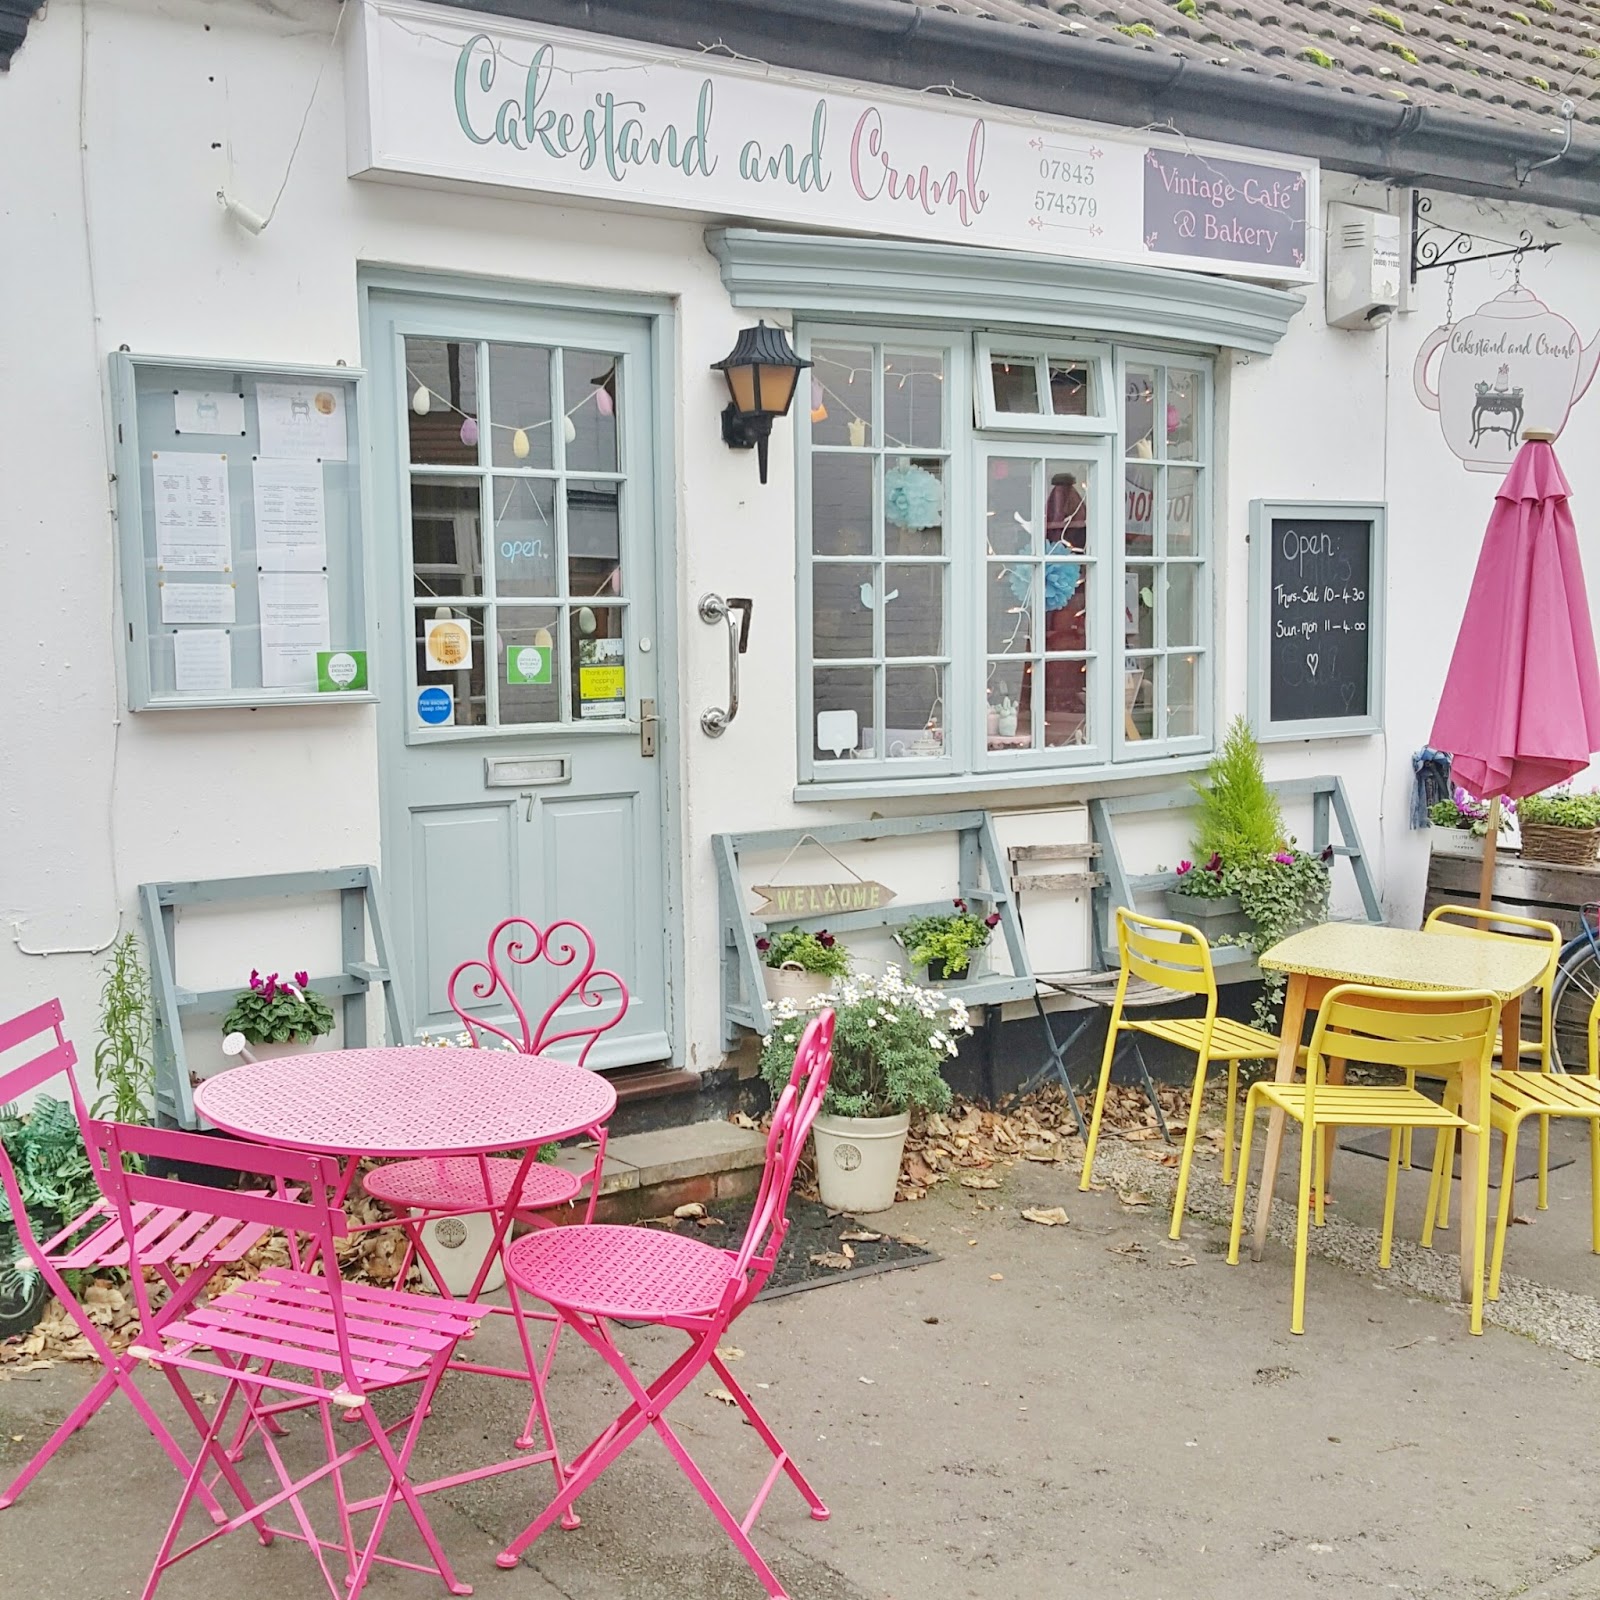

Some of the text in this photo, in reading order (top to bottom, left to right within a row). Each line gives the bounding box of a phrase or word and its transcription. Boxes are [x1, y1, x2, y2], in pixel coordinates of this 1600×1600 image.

[455, 34, 990, 227] Cakestand and Crumb
[1039, 158, 1095, 186] 07843
[1159, 165, 1292, 209] Vintage Café
[1034, 190, 1098, 218] 574379
[1173, 209, 1279, 253] & Bakery
[1507, 332, 1533, 356] and
[1535, 331, 1578, 360] Crumb
[520, 792, 537, 823] 7
[776, 885, 881, 912] WELCOME
